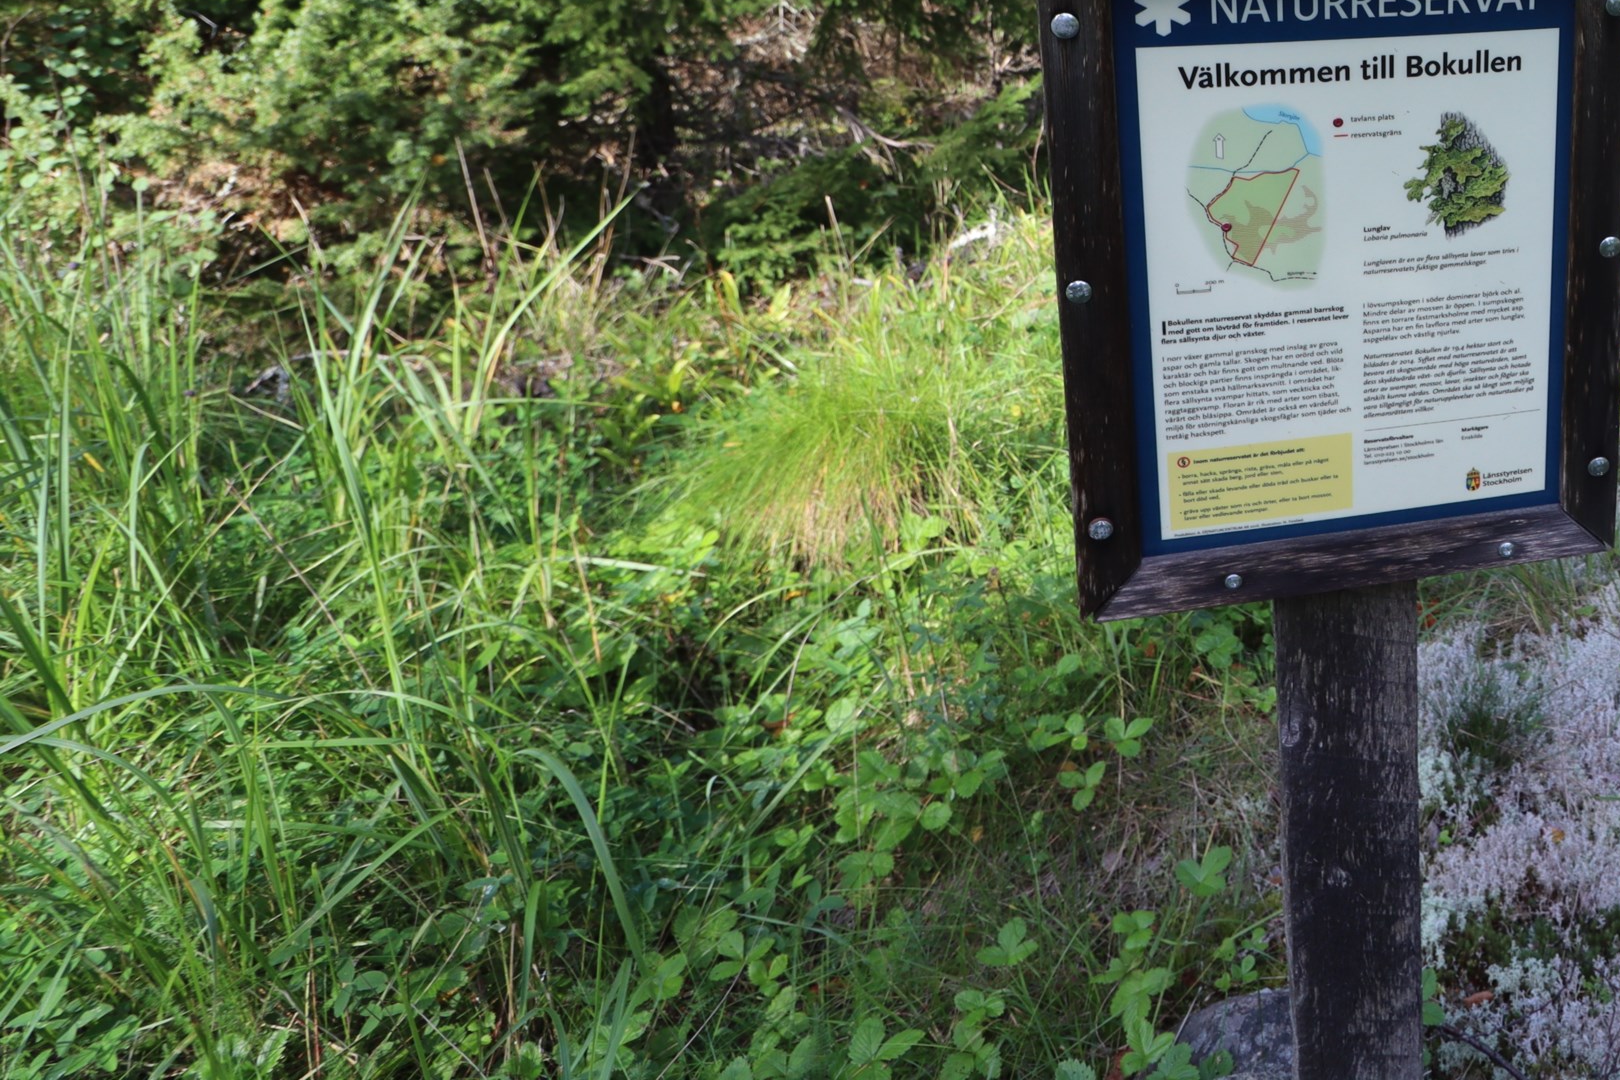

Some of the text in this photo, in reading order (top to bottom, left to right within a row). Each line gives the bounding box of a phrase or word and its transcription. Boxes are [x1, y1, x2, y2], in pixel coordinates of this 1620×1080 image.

[1177, 48, 1522, 90] Välkommen till Bokullen
[1350, 114, 1395, 123] tavlans plats
[1350, 130, 1402, 138] reservatsgräns
[1363, 224, 1391, 234] Lunglav
[1363, 231, 1428, 242] Lobaria pulmonaria
[1367, 299, 1421, 309] lövsumpskogen
[1446, 293, 1481, 301] dominerar
[1482, 290, 1499, 298] björk
[1482, 297, 1524, 306] sumpskogen
[1167, 318, 1203, 327] Bokullens
[1204, 314, 1253, 324] naturreservat
[1253, 311, 1282, 320] skyddas
[1283, 307, 1313, 318] gammal
[1313, 305, 1345, 314] barrskog
[1415, 310, 1470, 321] fastmarksholme
[1486, 306, 1510, 315] mycket
[1167, 327, 1185, 336] med
[1185, 327, 1201, 336] gott
[1215, 322, 1241, 331] lövträd
[1253, 319, 1292, 328] framtiden.
[1296, 315, 1331, 324] reservatet
[1362, 327, 1391, 335] Asparna
[1425, 320, 1450, 328] lavflora
[1500, 313, 1526, 321] lunglav,
[1178, 335, 1211, 344] sällsynta
[1211, 333, 1227, 342] djur
[1413, 330, 1436, 338] västlig
[1436, 328, 1461, 337] njurlav.
[1204, 350, 1234, 361] gammal
[1235, 347, 1268, 358] granskog
[1318, 341, 1338, 350] grova
[1199, 360, 1222, 370] gamla
[1244, 356, 1270, 364] Skogen
[1295, 351, 1315, 359] orörd
[1162, 372, 1192, 380] karaktär
[1193, 370, 1207, 378] och
[1241, 366, 1256, 374] gott
[1270, 360, 1309, 370] multnande
[1178, 379, 1208, 388] blockiga
[1209, 377, 1233, 386] partier
[1253, 370, 1293, 380] insprängda
[1298, 367, 1331, 376] området,
[1165, 424, 1184, 432] miljö
[1197, 417, 1259, 429] störningskänsliga
[1260, 412, 1299, 422] skogsfåglar
[1317, 408, 1338, 417] tjäder
[1190, 429, 1226, 438] hackspett.
[1482, 468, 1533, 480] Länsstyrelsen
[1482, 476, 1523, 487] Stockholm
